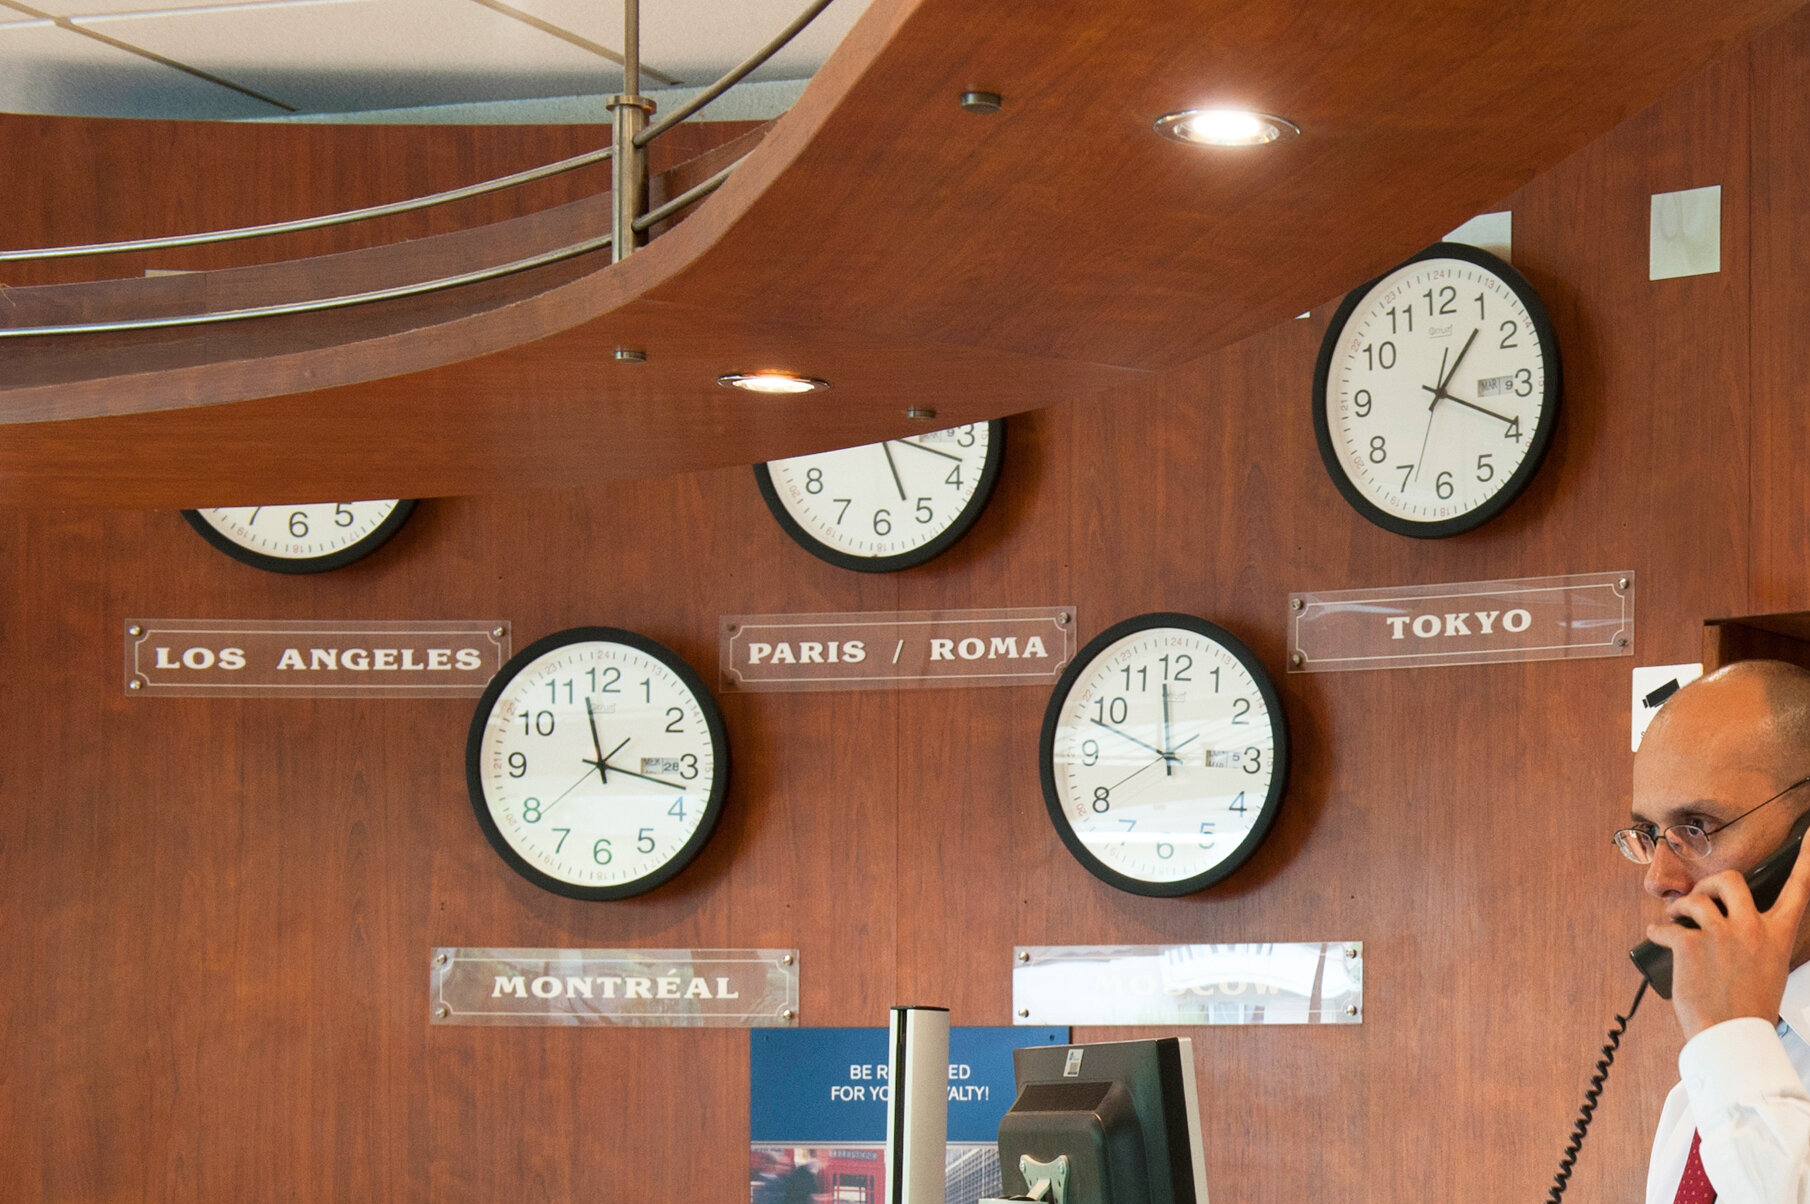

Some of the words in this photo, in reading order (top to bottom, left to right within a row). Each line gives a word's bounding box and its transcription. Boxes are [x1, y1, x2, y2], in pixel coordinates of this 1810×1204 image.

[1423, 286, 1456, 315] 12
[1475, 293, 1485, 320] 1
[1386, 304, 1413, 334] 11
[1500, 320, 1518, 349] 2
[1363, 341, 1396, 370] 10
[1505, 380, 1513, 390] 9
[1515, 368, 1532, 397] 3
[1355, 390, 1371, 417] 9
[957, 424, 975, 447] 3
[1505, 416, 1522, 443] 4
[1370, 436, 1386, 463] 8
[806, 468, 823, 494] 8
[945, 465, 963, 490] 4
[1396, 465, 1414, 493] 7
[1477, 454, 1494, 482] 5
[1436, 472, 1453, 499] 6
[335, 502, 354, 527] 5
[833, 499, 851, 525] 7
[873, 509, 891, 536] 6
[915, 498, 933, 523] 5
[289, 511, 308, 537] 6
[1387, 609, 1532, 639] TOKYO
[156, 647, 246, 670] LOS
[276, 648, 482, 671] ANGELES
[748, 640, 866, 664] PARIS
[892, 640, 904, 664] /
[930, 636, 1048, 661] ROMA
[585, 667, 621, 693] 12
[1121, 665, 1147, 692] 11
[1159, 654, 1192, 681] 12
[1210, 667, 1219, 693] 1
[545, 679, 573, 704] 11
[640, 678, 650, 703] 1
[519, 710, 555, 736] 10
[665, 707, 684, 733] 2
[1094, 697, 1127, 724] 10
[1232, 698, 1250, 724] 2
[508, 752, 527, 778] 9
[679, 753, 698, 779] 3
[1082, 740, 1098, 766] 9
[1243, 747, 1261, 774] 3
[663, 762, 679, 771] 28
[523, 797, 541, 823] 8
[668, 796, 686, 822] 4
[1092, 787, 1109, 813] 8
[1229, 791, 1247, 818] 4
[552, 828, 571, 854] 7
[637, 828, 655, 853] 5
[1118, 819, 1136, 846] 7
[1157, 832, 1174, 859] 6
[1199, 823, 1216, 849] 5
[593, 839, 612, 865] 6
[491, 968, 739, 999] MONTRÉAL
[850, 1065, 872, 1080] BE
[831, 1086, 865, 1101] FOR
